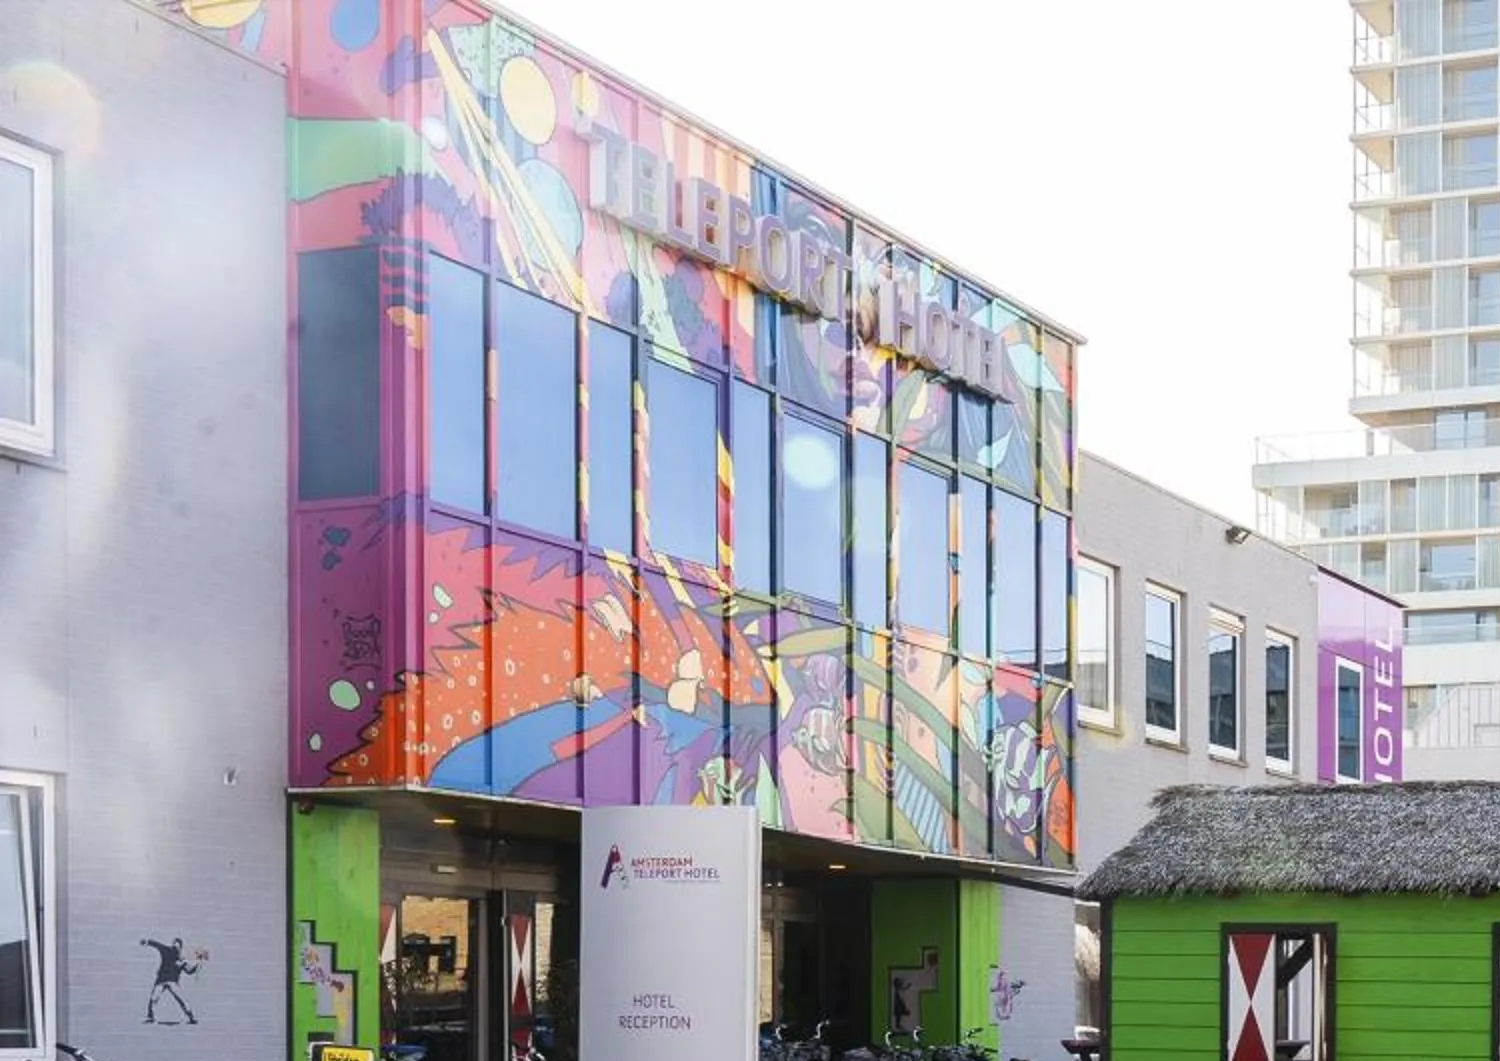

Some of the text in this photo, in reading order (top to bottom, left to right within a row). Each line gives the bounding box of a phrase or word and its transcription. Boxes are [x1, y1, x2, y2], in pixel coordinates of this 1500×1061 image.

[575, 120, 1007, 400] TELEPORT HOTEL
[631, 856, 693, 867] AMSTERDAM
[633, 868, 720, 879] TELEPORT HOTEL
[633, 994, 676, 1009] HOTEL
[618, 1015, 691, 1030] RECEPTION
